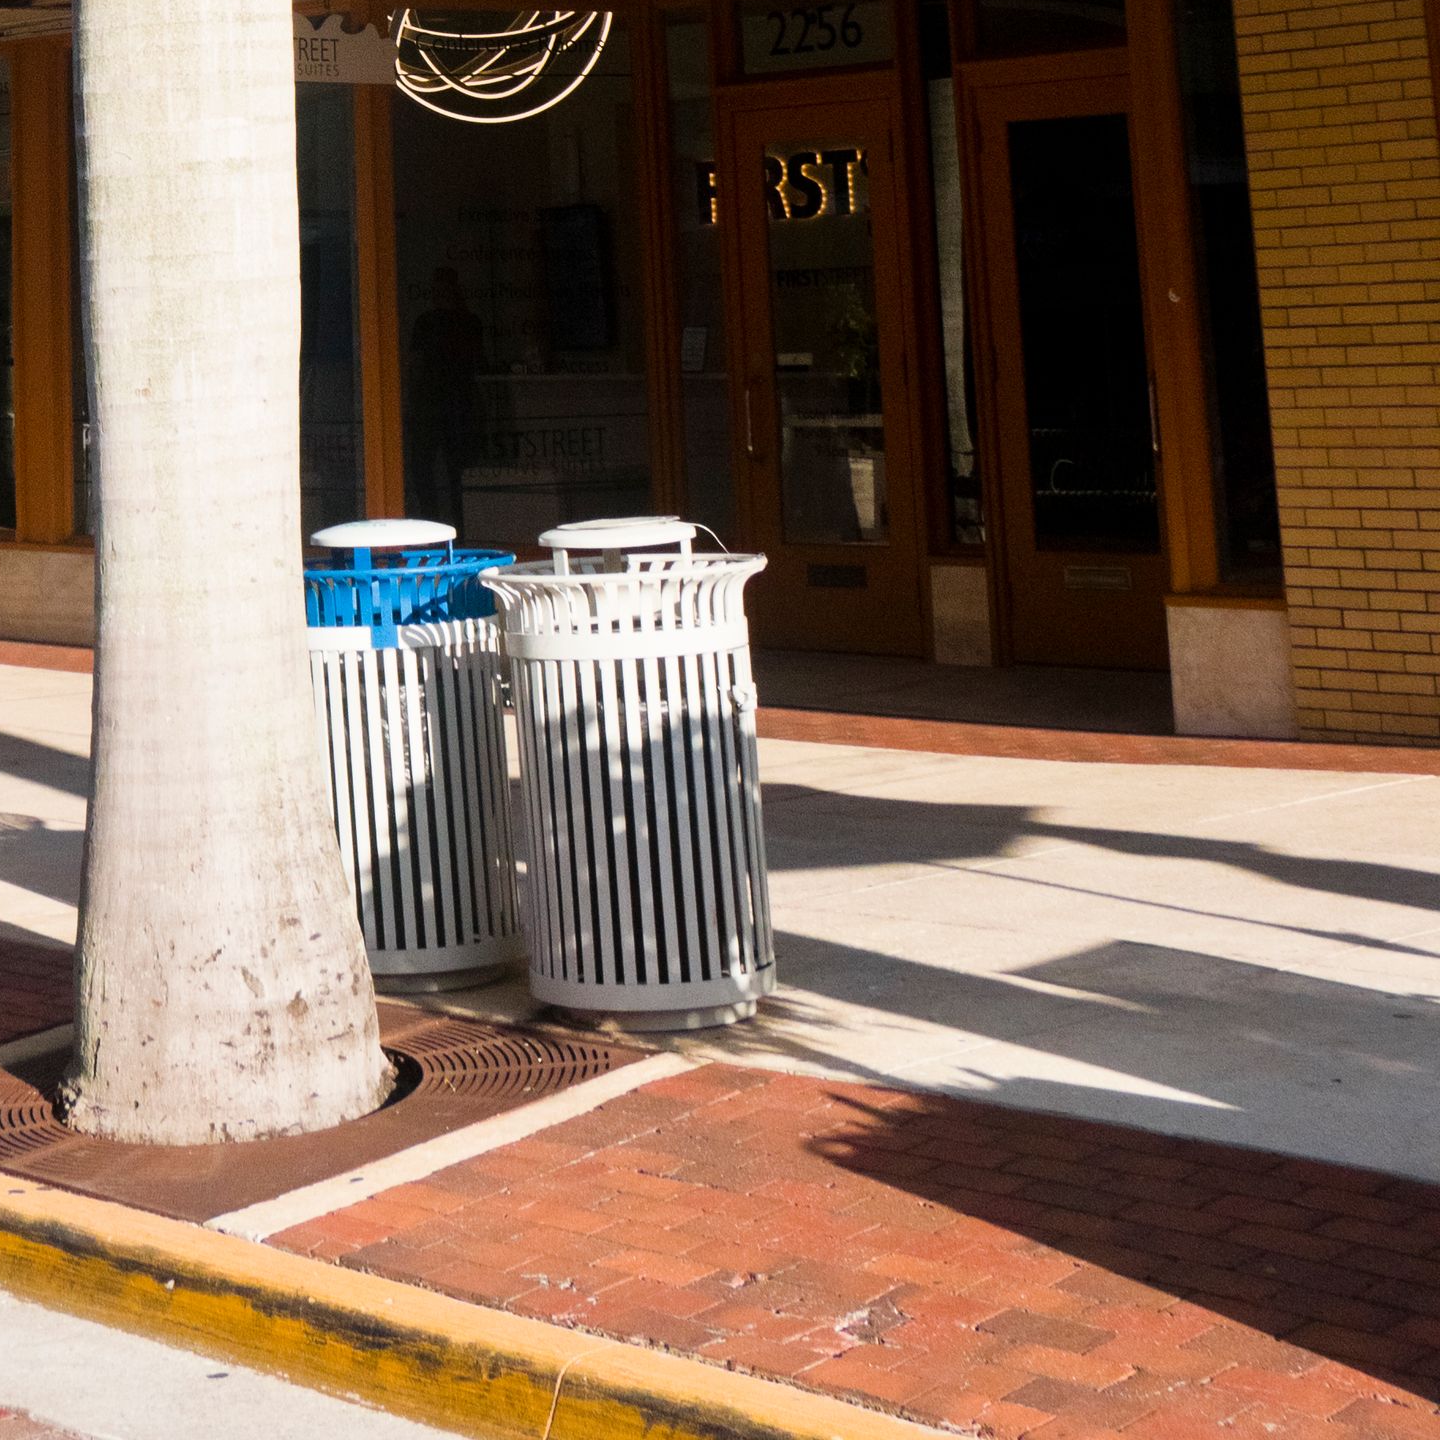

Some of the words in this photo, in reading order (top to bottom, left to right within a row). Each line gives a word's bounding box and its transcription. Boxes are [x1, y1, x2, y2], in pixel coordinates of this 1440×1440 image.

[767, 4, 862, 55] 2256
[294, 37, 339, 63] REET
[297, 64, 340, 77] SUITES
